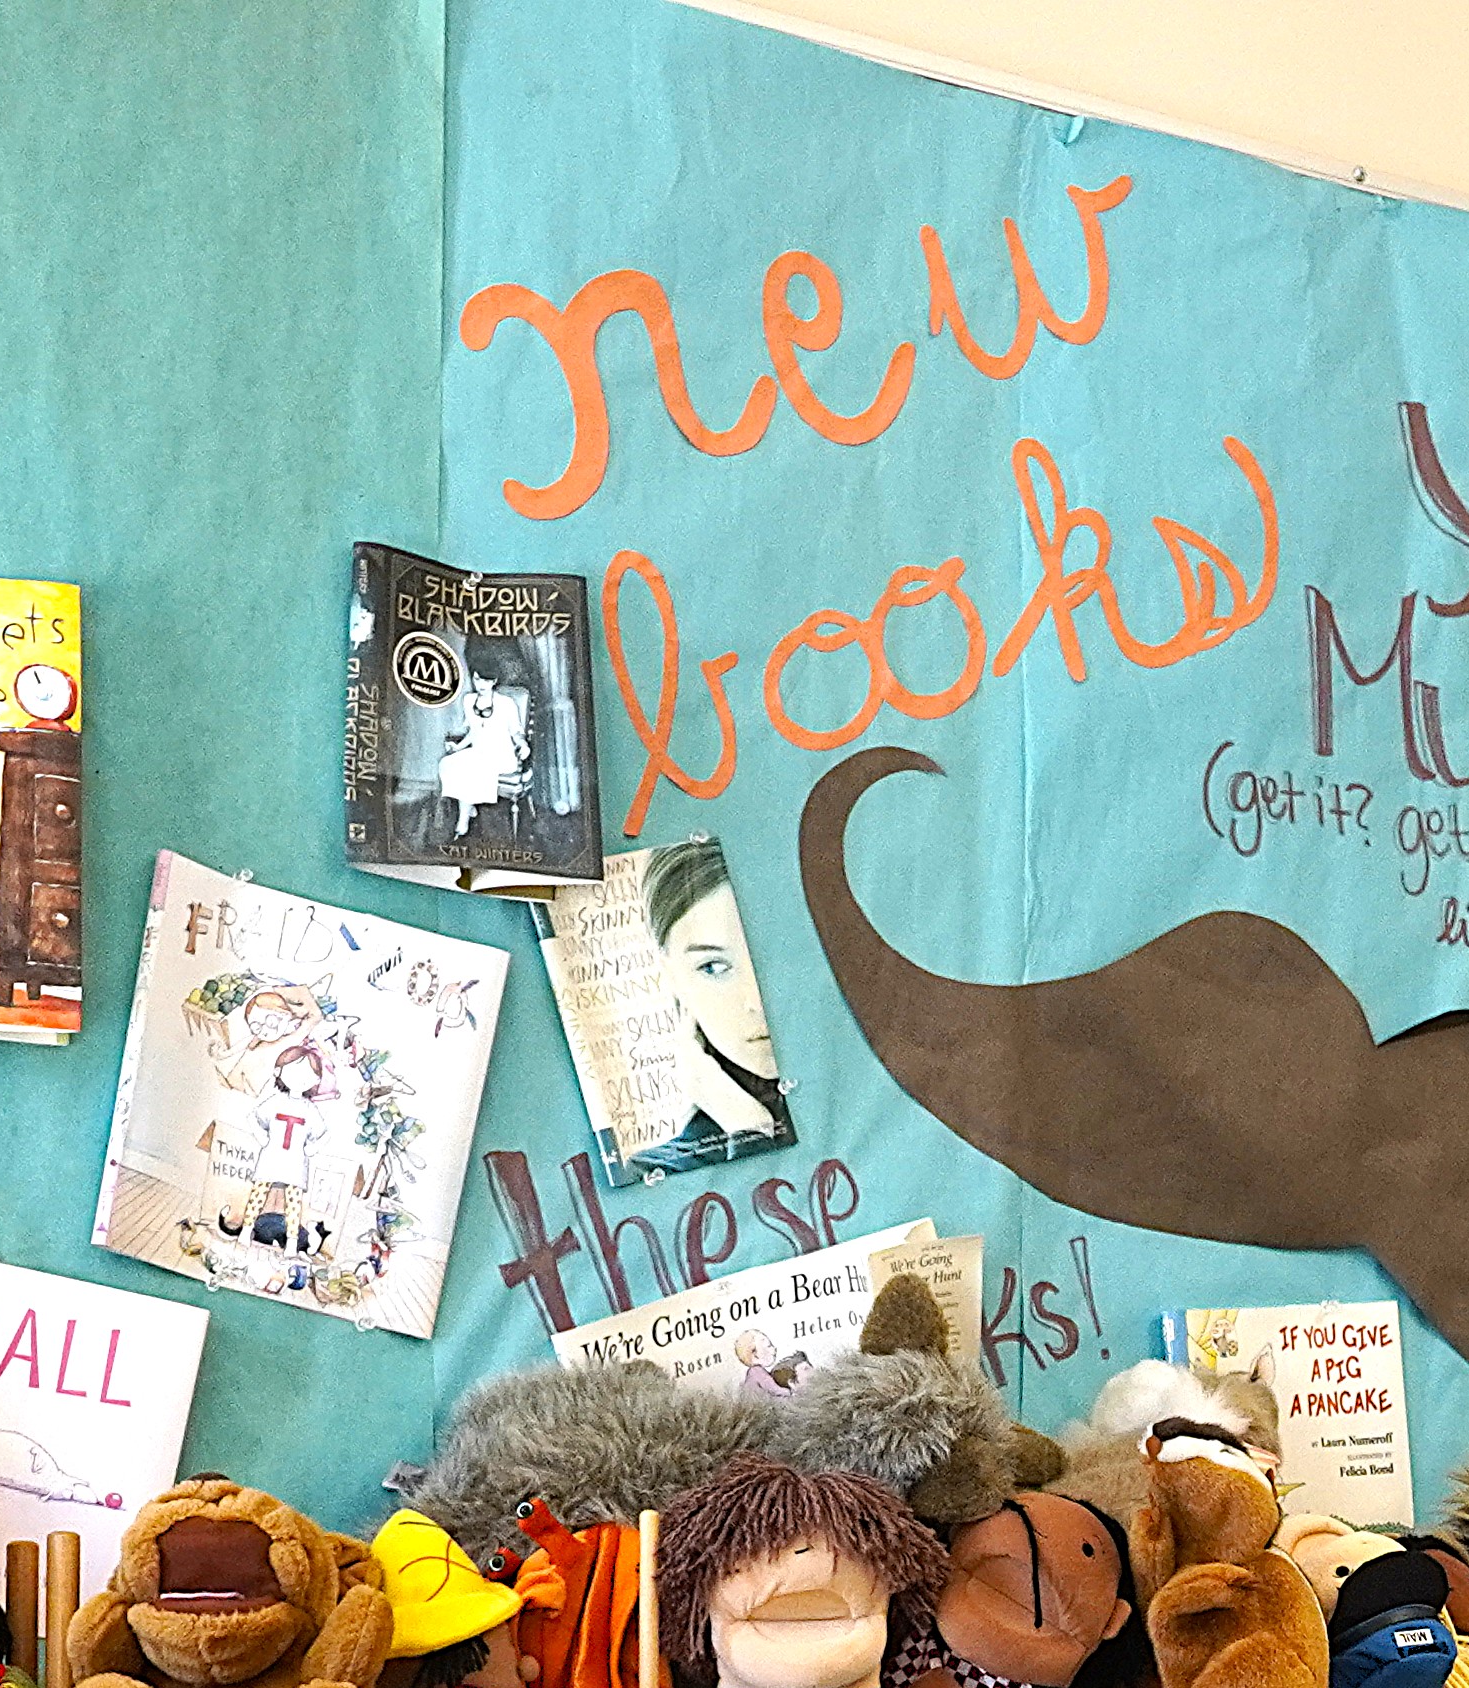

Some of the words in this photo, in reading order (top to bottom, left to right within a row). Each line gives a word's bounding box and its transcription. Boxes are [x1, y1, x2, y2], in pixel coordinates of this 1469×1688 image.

[460, 174, 1131, 519] new
[423, 575, 539, 612] SHADOW
[397, 593, 571, 637] BLACKBIRDS
[603, 437, 1278, 837] books
[413, 656, 441, 685] M
[1313, 782, 1374, 846] it?
[482, 1151, 860, 1334] these
[581, 1331, 644, 1363] We're
[652, 1306, 723, 1349] Going
[730, 1296, 758, 1324] on
[769, 1288, 784, 1309] a
[791, 1272, 842, 1303] Bear
[793, 1316, 842, 1340] Helen
[1279, 1324, 1298, 1351] IF
[1303, 1323, 1336, 1349] YOU
[1342, 1324, 1393, 1352] GIVE
[674, 1350, 723, 1379] Rosen
[1311, 1359, 1321, 1383] A
[1326, 1355, 1361, 1384] PIG
[1290, 1394, 1302, 1418] A
[1308, 1388, 1392, 1417] PANCAKE
